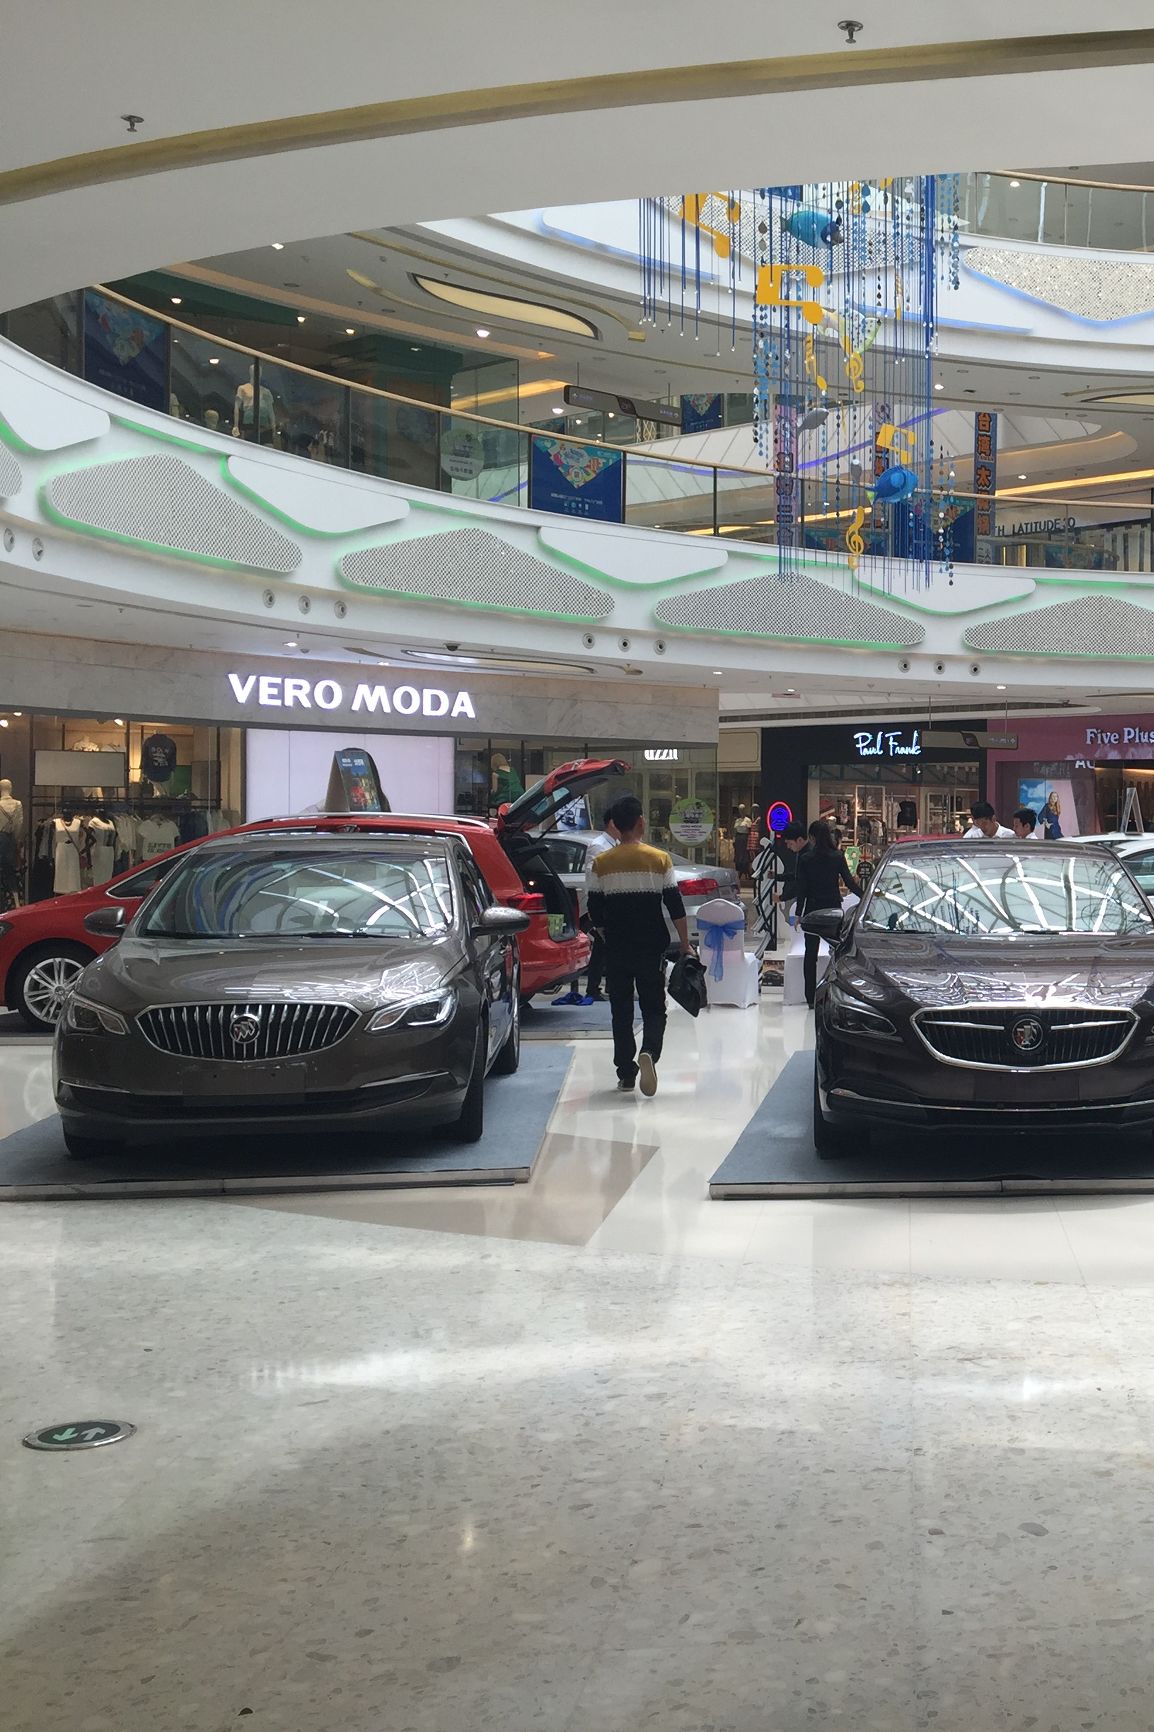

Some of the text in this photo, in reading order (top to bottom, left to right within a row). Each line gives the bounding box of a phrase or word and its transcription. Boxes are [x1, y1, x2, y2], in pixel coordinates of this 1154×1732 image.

[228, 673, 476, 719] VERO MODA
[853, 730, 922, 756] Paul Frank
[1085, 729, 1120, 745] Five
